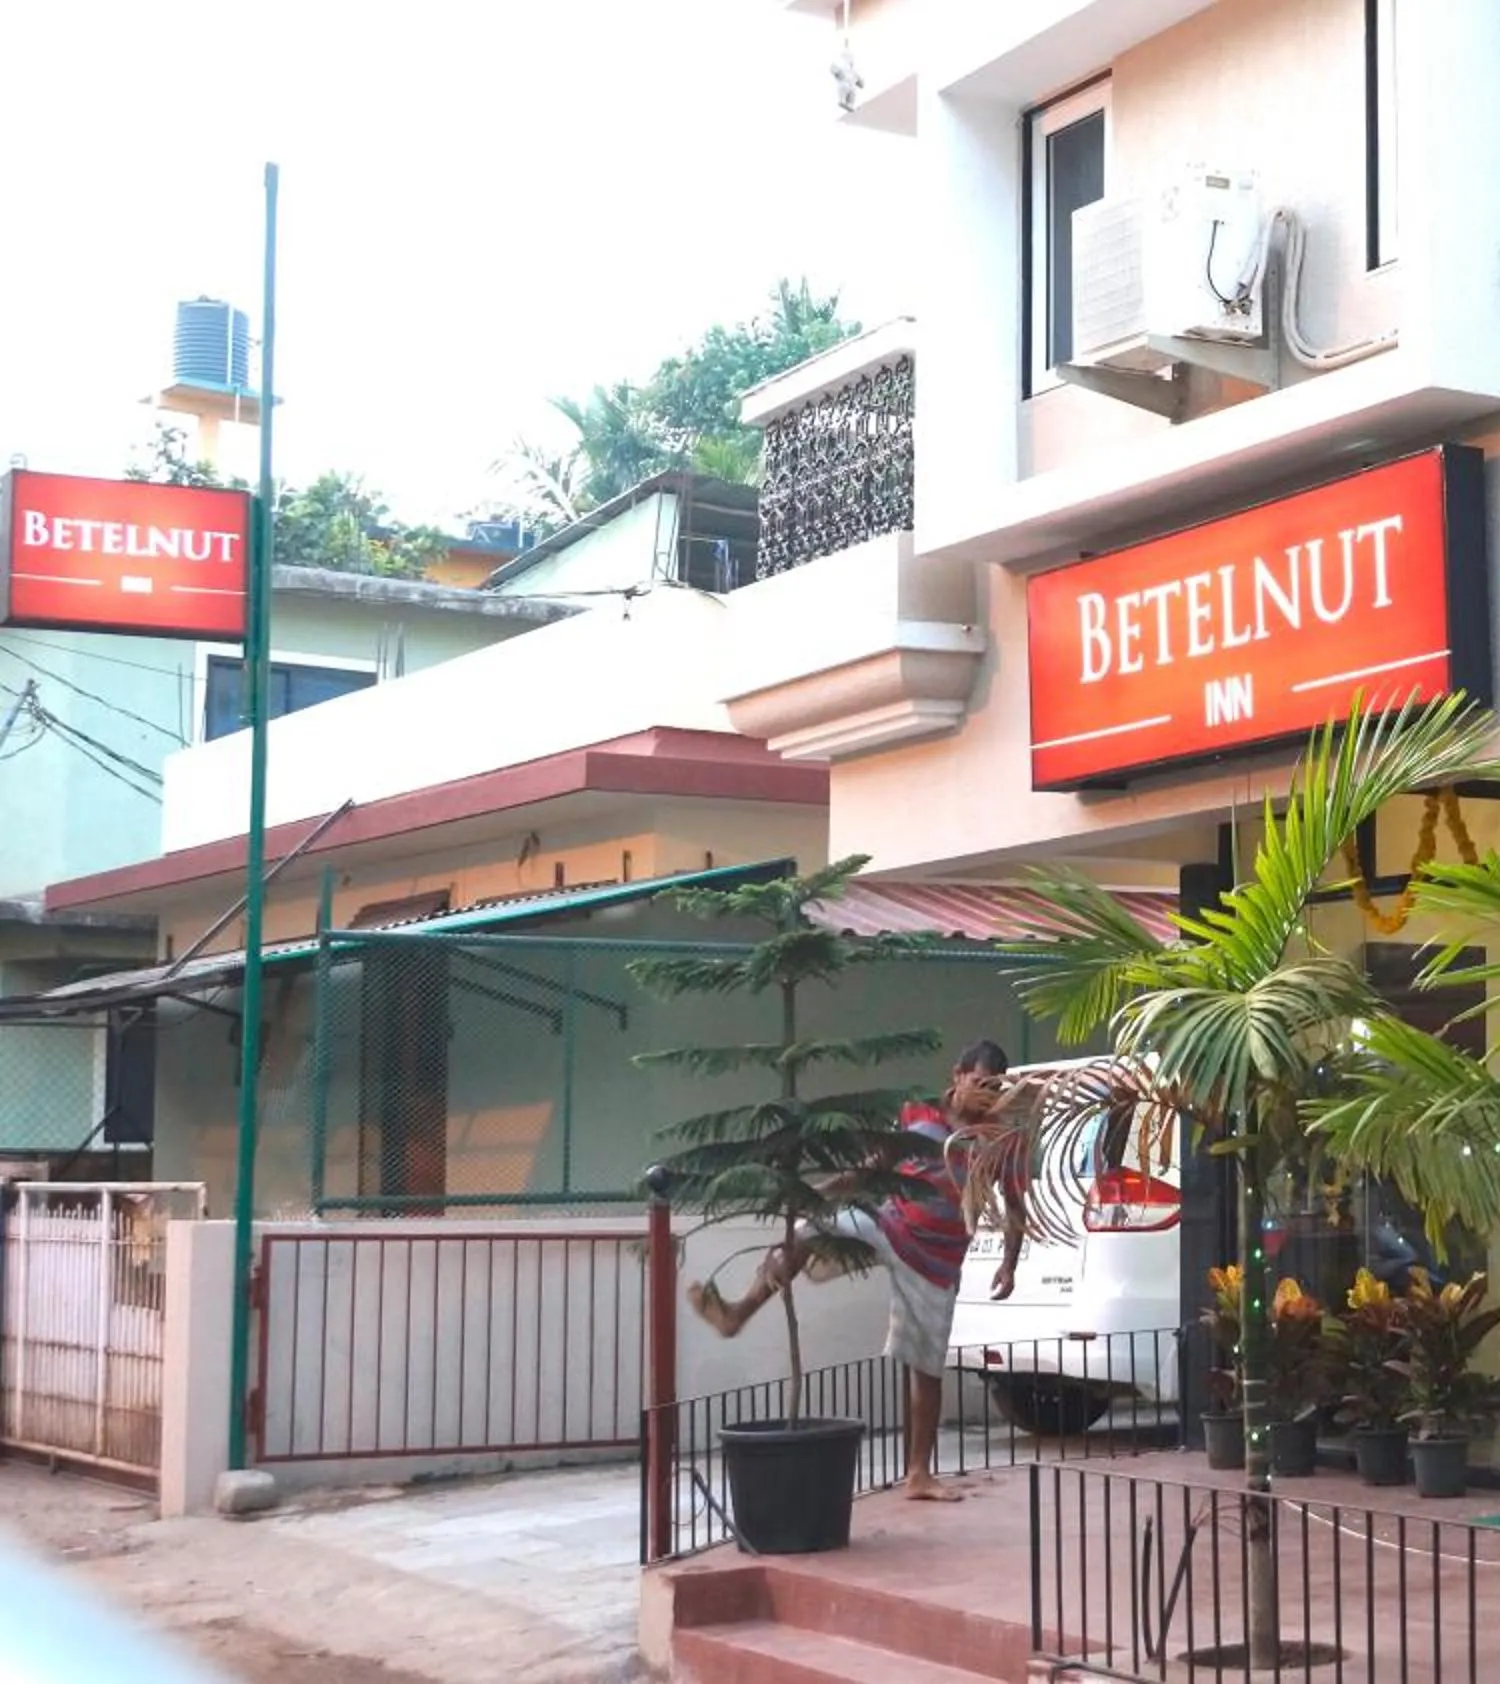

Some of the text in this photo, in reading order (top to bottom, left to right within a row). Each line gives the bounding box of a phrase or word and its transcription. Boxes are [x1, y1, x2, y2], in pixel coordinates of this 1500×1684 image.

[23, 510, 240, 562] BETELNUT
[1077, 514, 1404, 684] BETELNUT
[1205, 673, 1253, 727] INN
